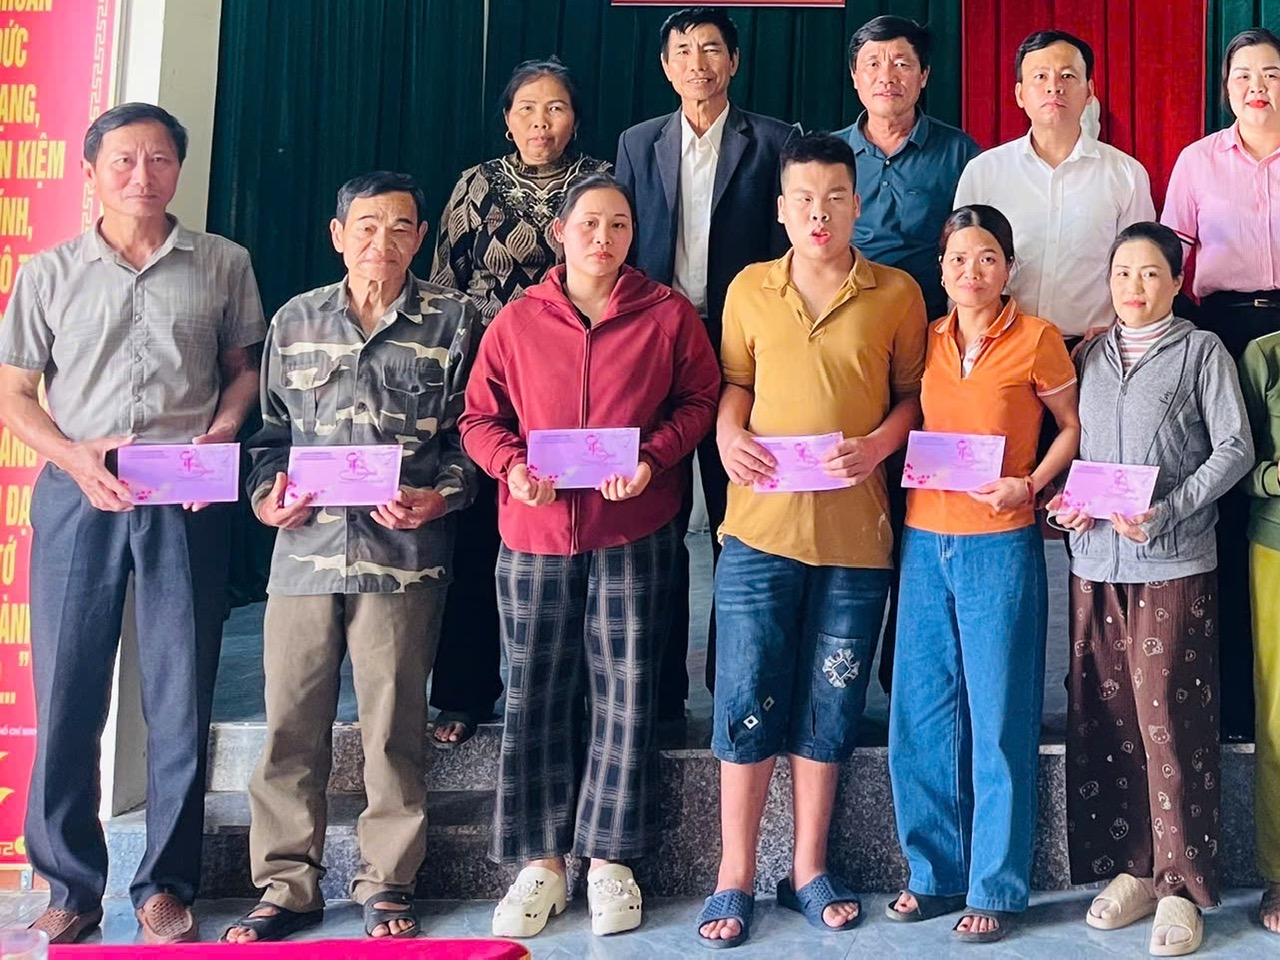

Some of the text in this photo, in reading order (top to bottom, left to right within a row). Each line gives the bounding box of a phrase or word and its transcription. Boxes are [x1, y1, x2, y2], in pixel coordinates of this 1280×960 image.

[0, 20, 29, 68] ỨC
[17, 132, 66, 189] KIỆM
[6, 485, 32, 536] ĐẠ
